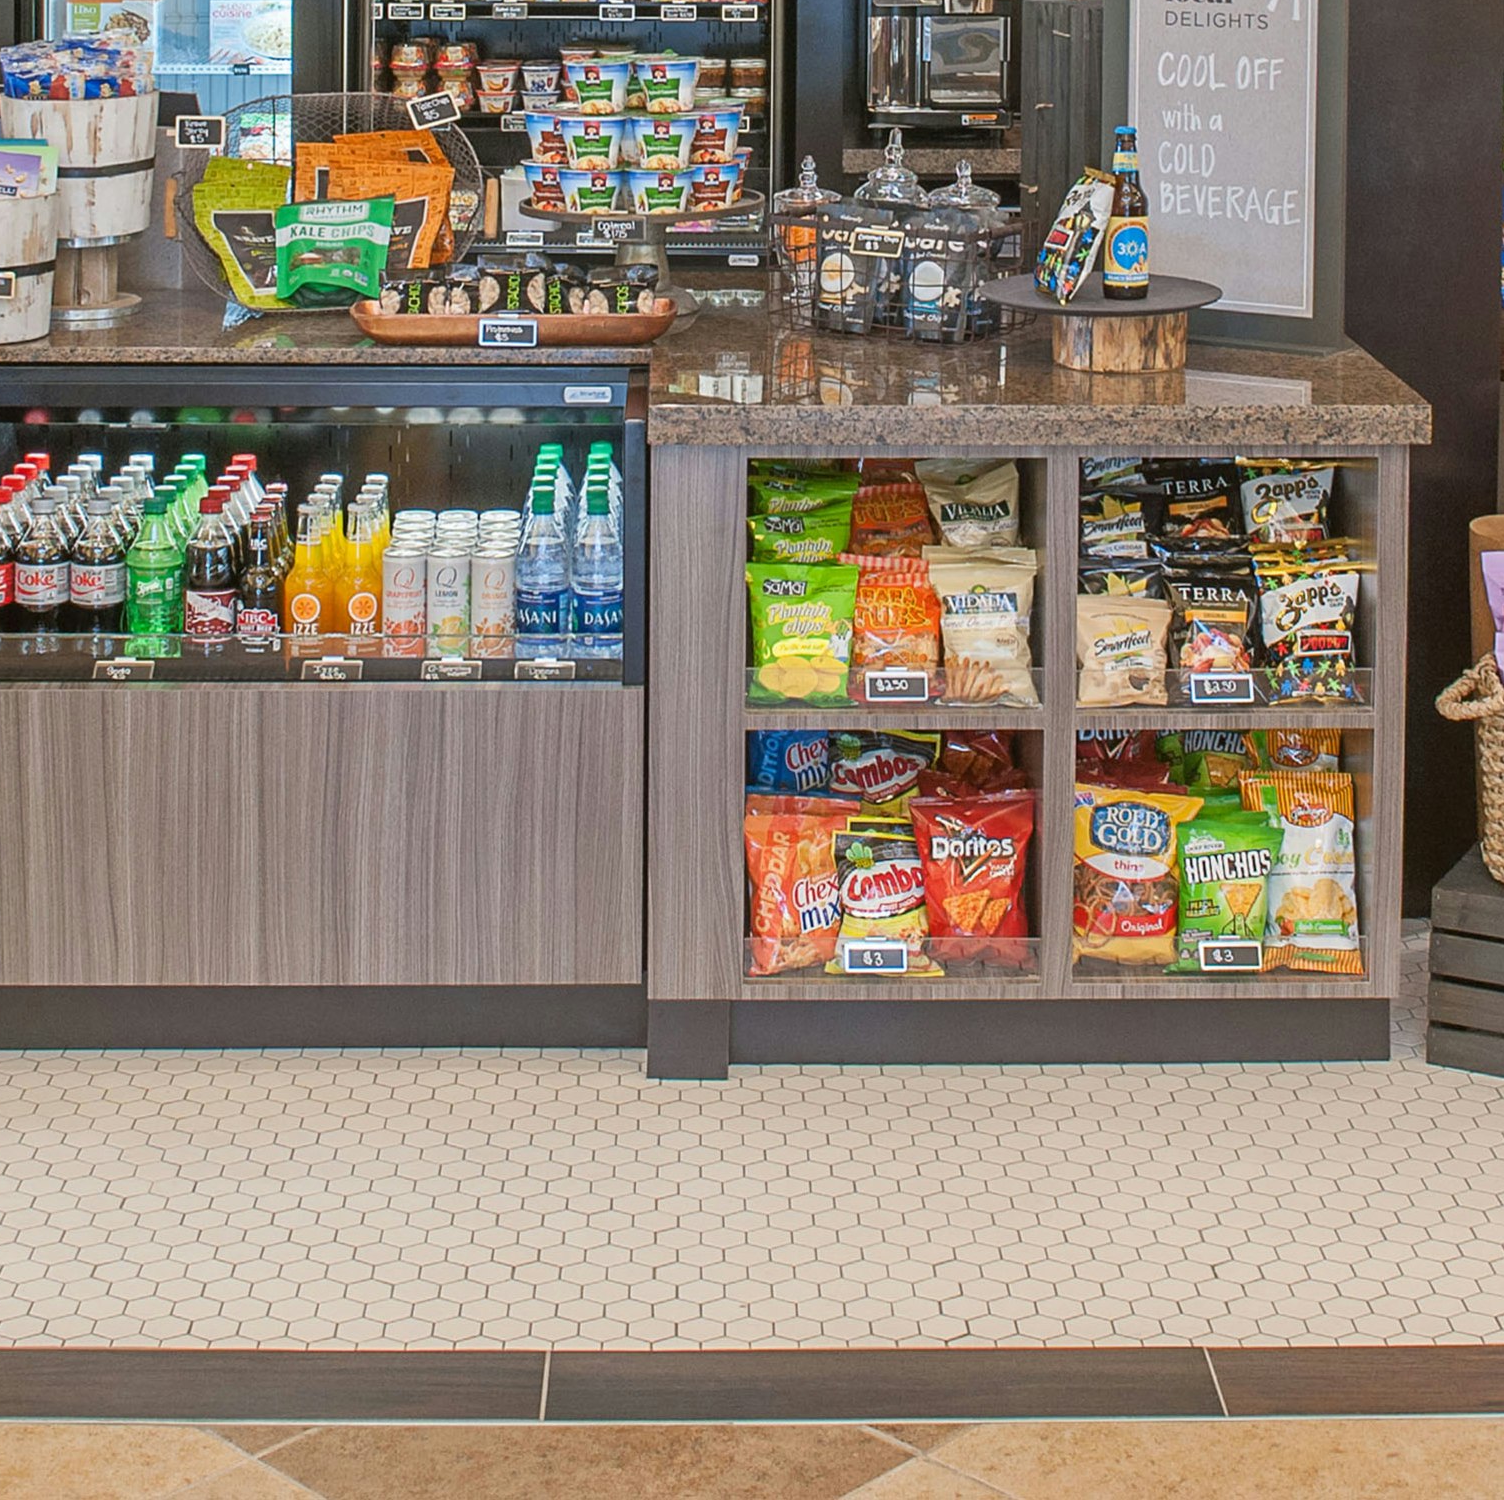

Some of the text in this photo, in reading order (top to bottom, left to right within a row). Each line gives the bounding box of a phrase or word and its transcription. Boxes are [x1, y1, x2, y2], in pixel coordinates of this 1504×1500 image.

[1165, 10, 1269, 30] DELIGHTS
[1157, 51, 1285, 92] COOL OFF
[1161, 105, 1223, 132] with a
[1158, 140, 1216, 179] COLD
[305, 204, 364, 216] RHYTHM
[1159, 180, 1302, 225] BEVERAGE
[289, 223, 376, 239] KALE CHIPS
[1163, 475, 1229, 496] TERRA
[16, 569, 55, 586] Coke
[393, 566, 415, 589] Q
[435, 566, 457, 589] Q
[483, 566, 506, 589] Q
[946, 594, 1013, 612] VIDALIA
[1178, 587, 1249, 601] TERRA
[245, 613, 267, 624] IBC
[293, 621, 319, 635] IZZE
[350, 621, 376, 635] IZZE
[786, 737, 829, 770] Chex
[834, 755, 921, 789] Combos
[931, 836, 1015, 860] Doritos
[1097, 823, 1162, 850] GOLD
[1184, 848, 1272, 885] HONCHOS
[754, 830, 791, 932] CHEDDAR
[793, 874, 839, 908] Chex
[847, 863, 925, 901] Combo
[801, 899, 842, 933] mix
[1120, 918, 1164, 934] Original
